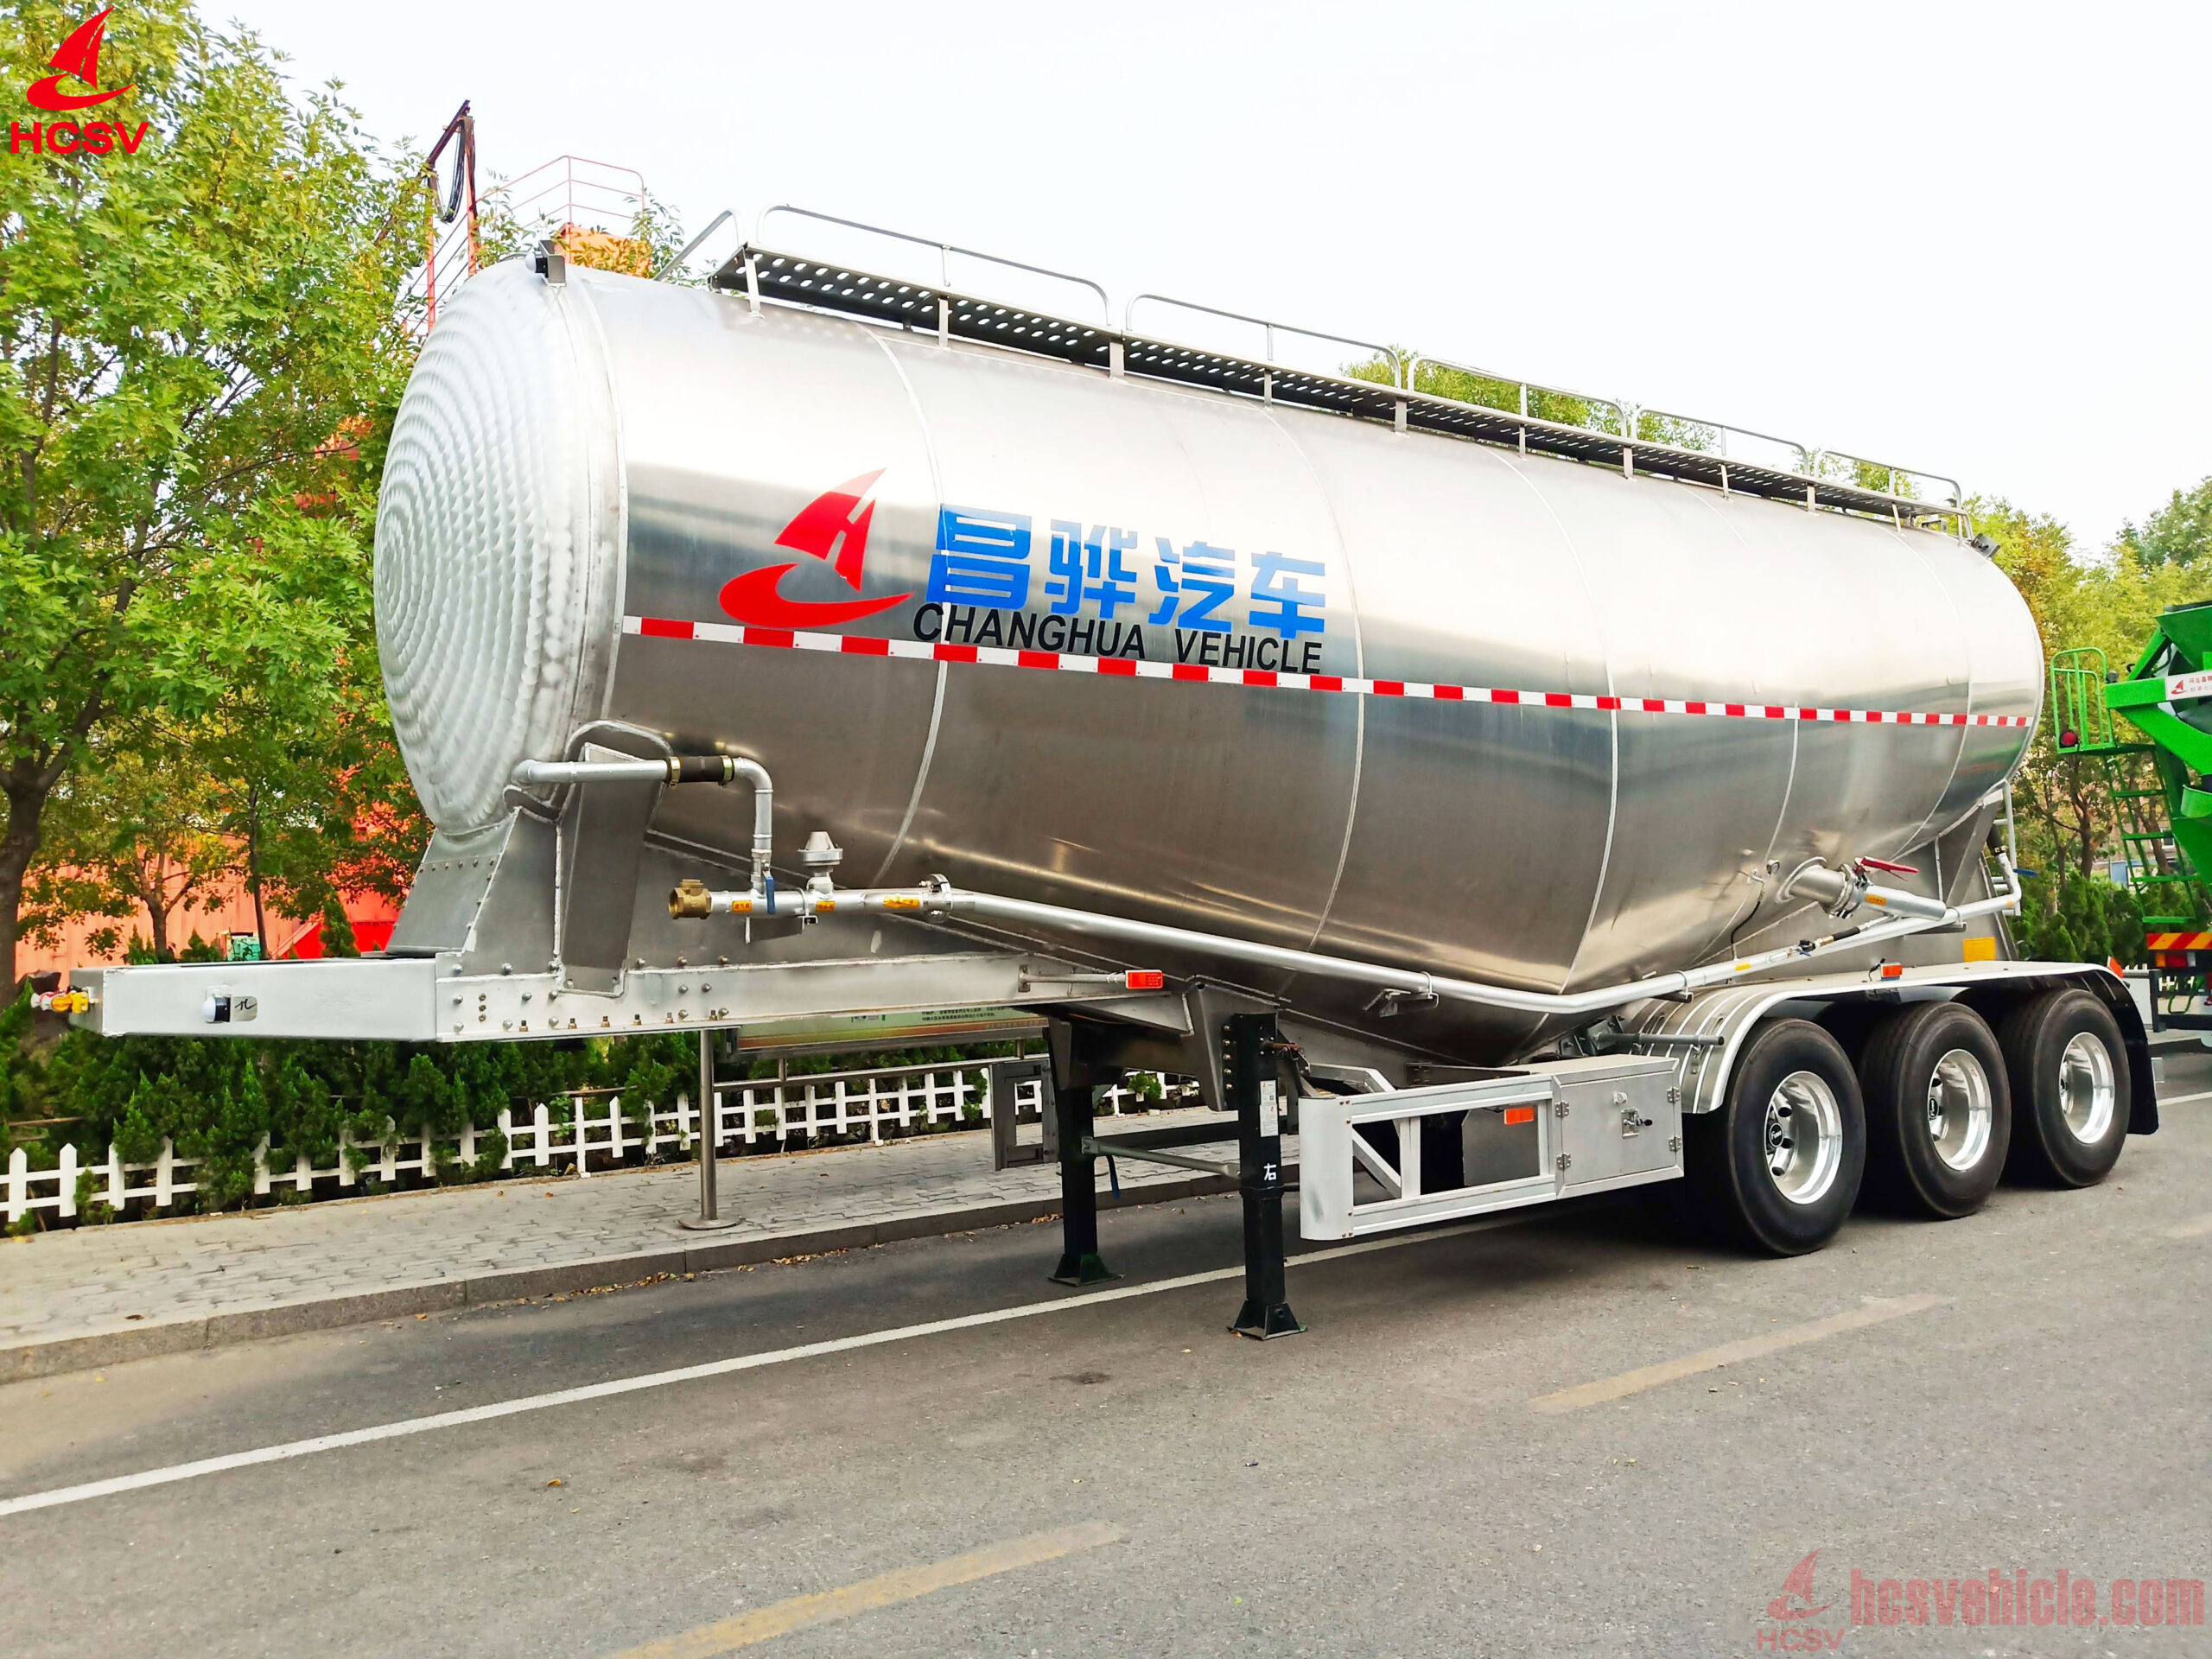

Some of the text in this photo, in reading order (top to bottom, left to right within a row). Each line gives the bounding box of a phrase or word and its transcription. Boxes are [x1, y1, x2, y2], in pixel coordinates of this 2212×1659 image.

[925, 503, 1325, 640] 昌骅汽车
[913, 602, 1322, 675] CHANGHUA VEHICLE
[1263, 1162, 1277, 1181] 右
